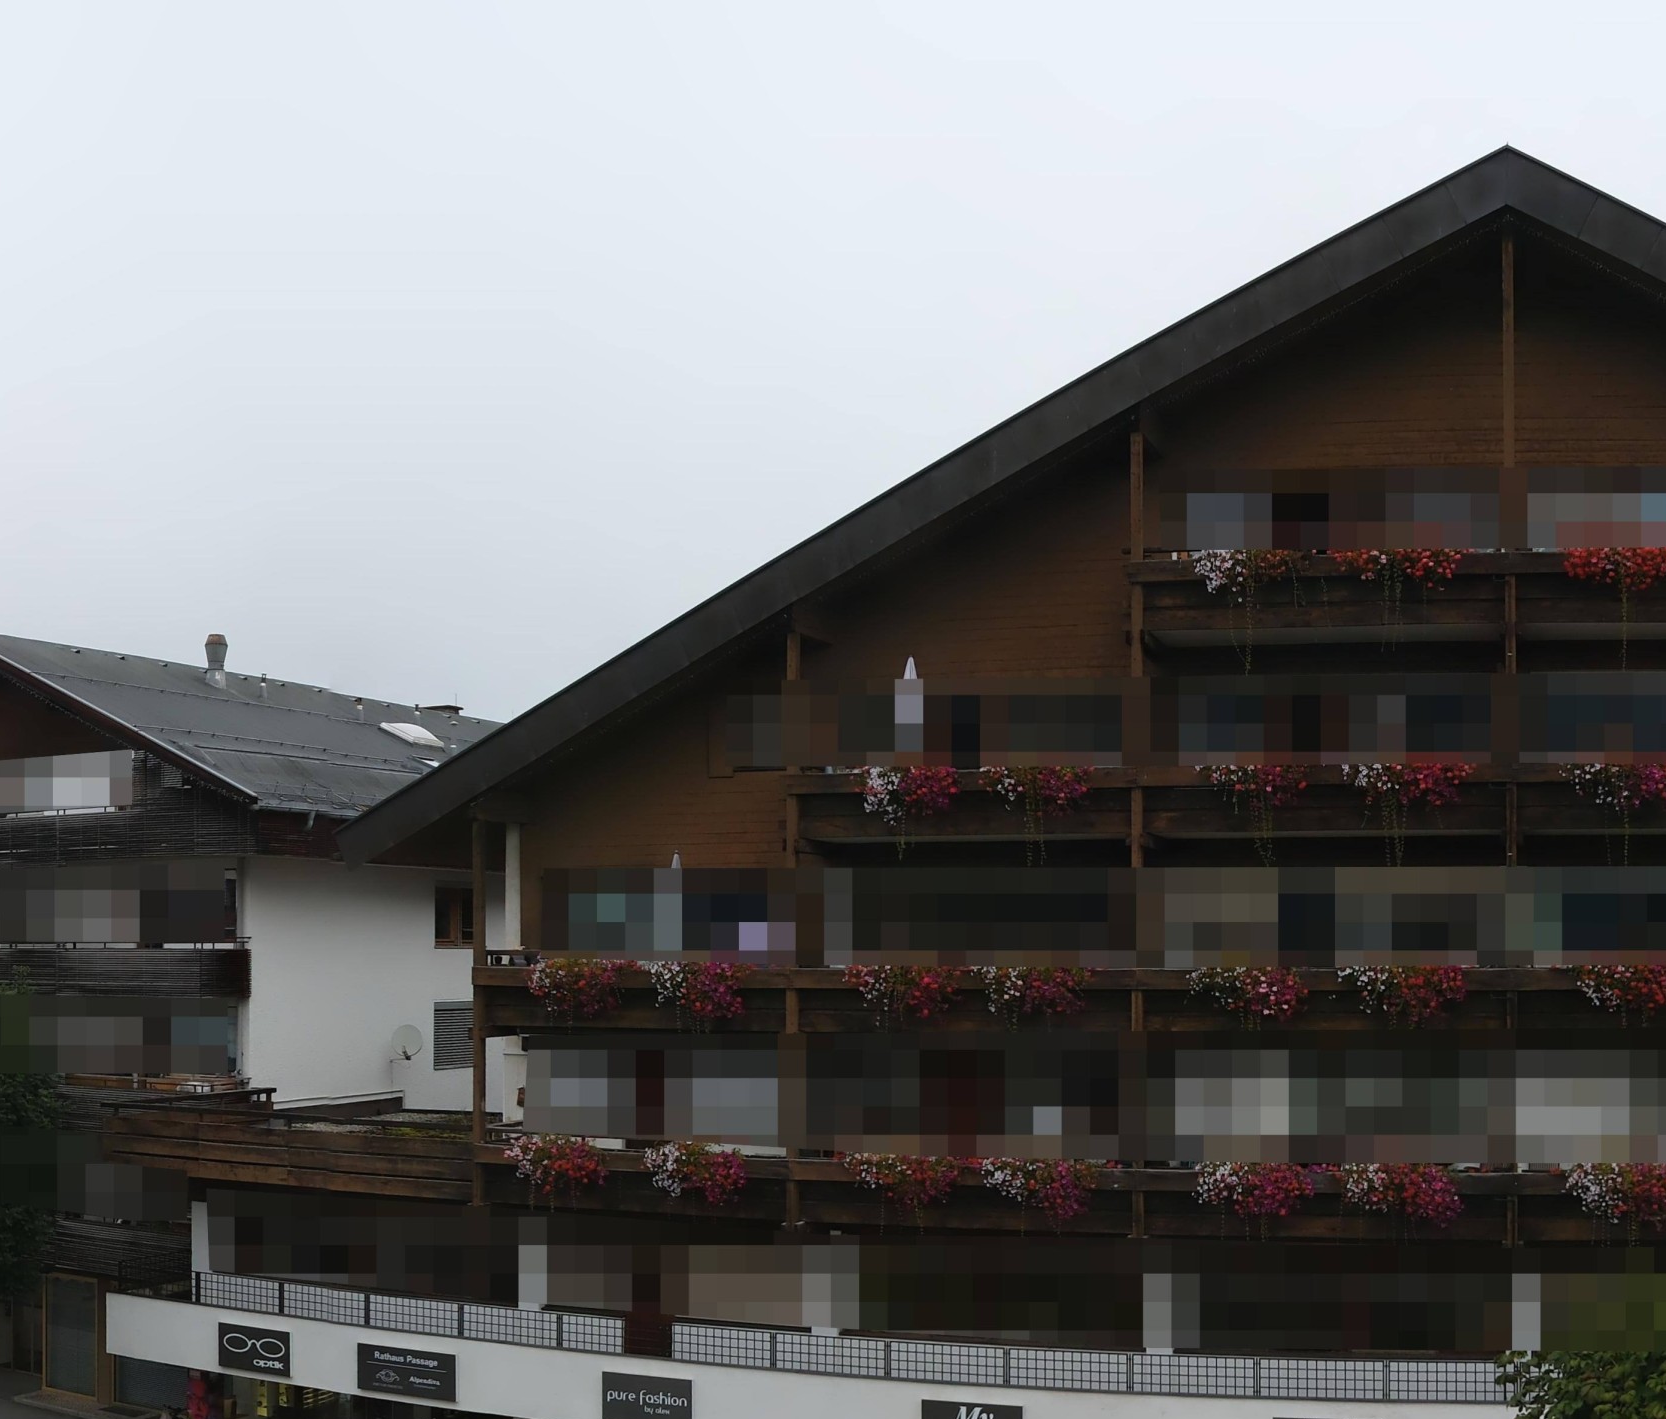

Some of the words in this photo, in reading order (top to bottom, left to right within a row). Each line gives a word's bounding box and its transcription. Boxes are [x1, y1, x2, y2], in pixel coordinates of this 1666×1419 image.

[253, 1358, 284, 1370] optik
[374, 1350, 404, 1363] Rathaus
[406, 1355, 438, 1368] Passage
[607, 1389, 636, 1402] pure
[639, 1389, 688, 1407] fashion
[644, 1406, 653, 1415] by
